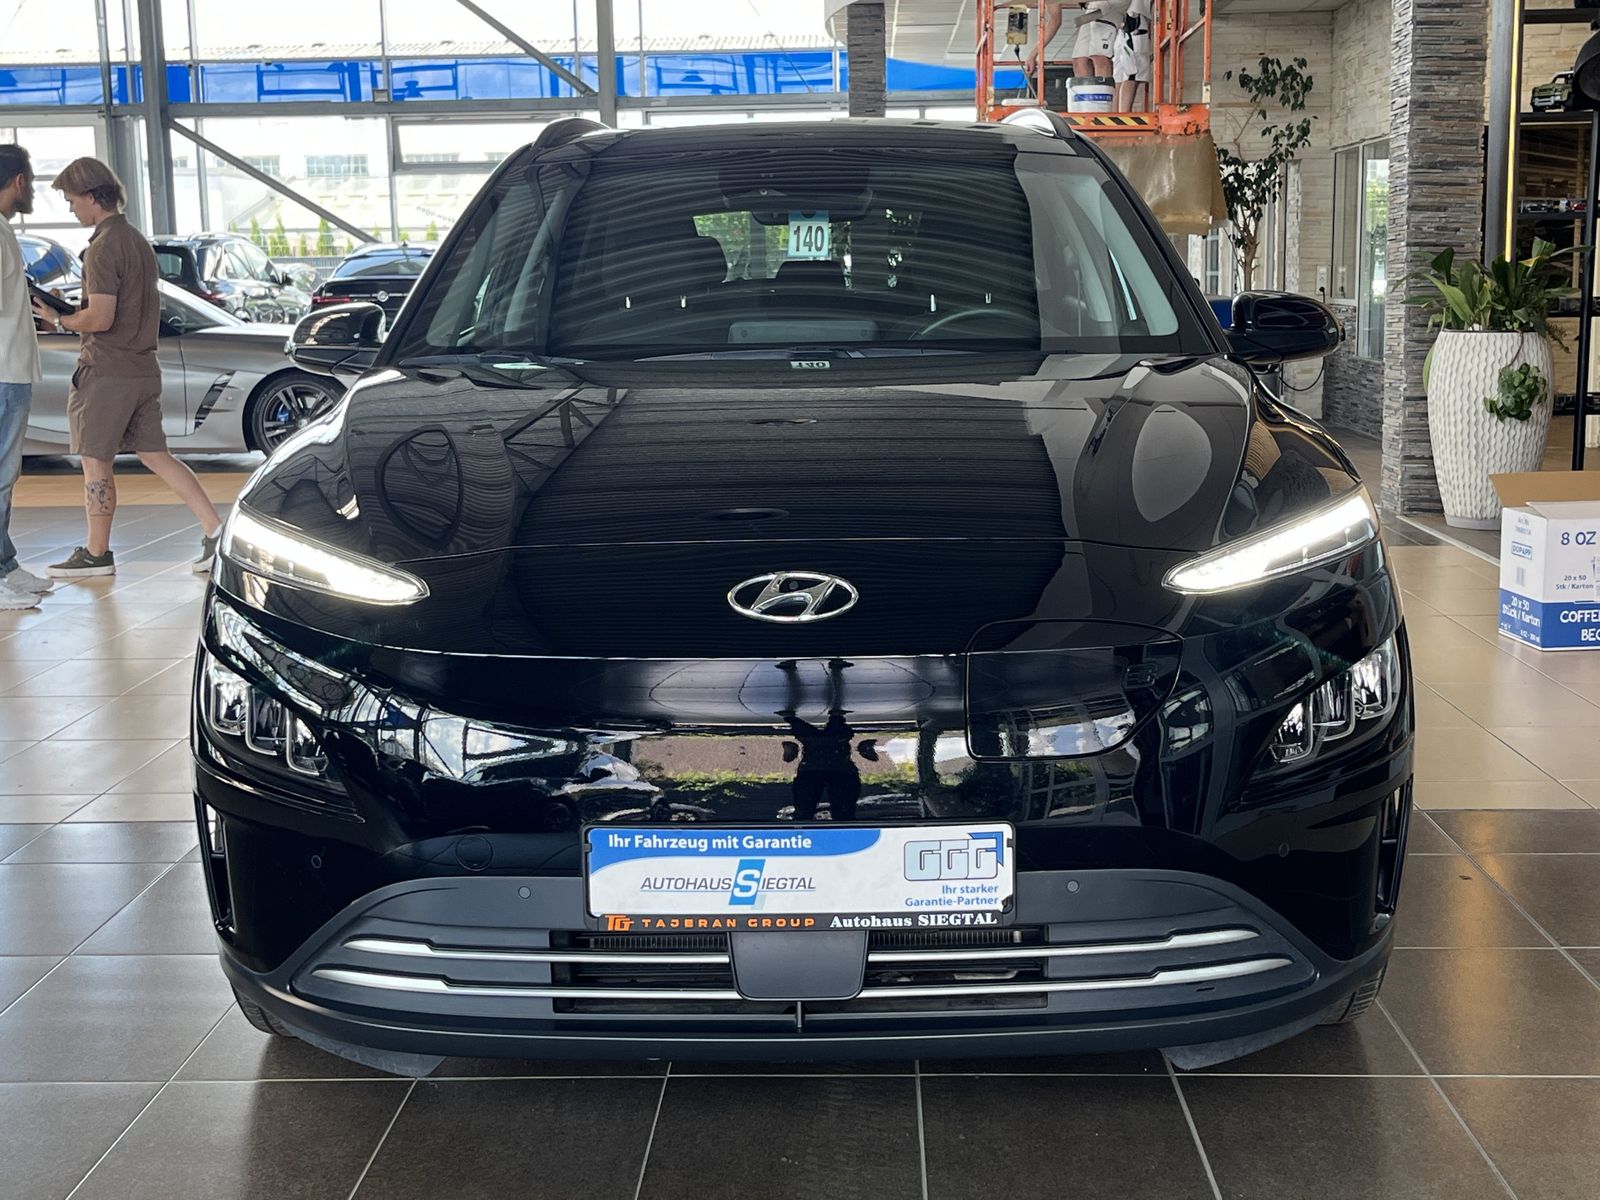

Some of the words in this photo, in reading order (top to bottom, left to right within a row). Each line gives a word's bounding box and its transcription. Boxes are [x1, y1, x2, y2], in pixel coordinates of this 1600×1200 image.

[793, 225, 825, 252] 140
[1561, 531, 1570, 546] 8
[1575, 531, 1597, 545] OZ
[1560, 609, 1600, 623] COFFE
[608, 834, 631, 848] Ihr
[634, 834, 708, 852] Fahrzeug
[712, 834, 739, 848] mit
[742, 835, 812, 849] Garantie
[942, 885, 957, 894] Ihr
[959, 884, 999, 894] starker
[905, 897, 999, 907] Garantie-Partner
[642, 918, 737, 928] TAJERAN
[748, 917, 815, 928] GROUP
[830, 915, 913, 928] Autohaus
[918, 913, 997, 926] SIEGTAL
